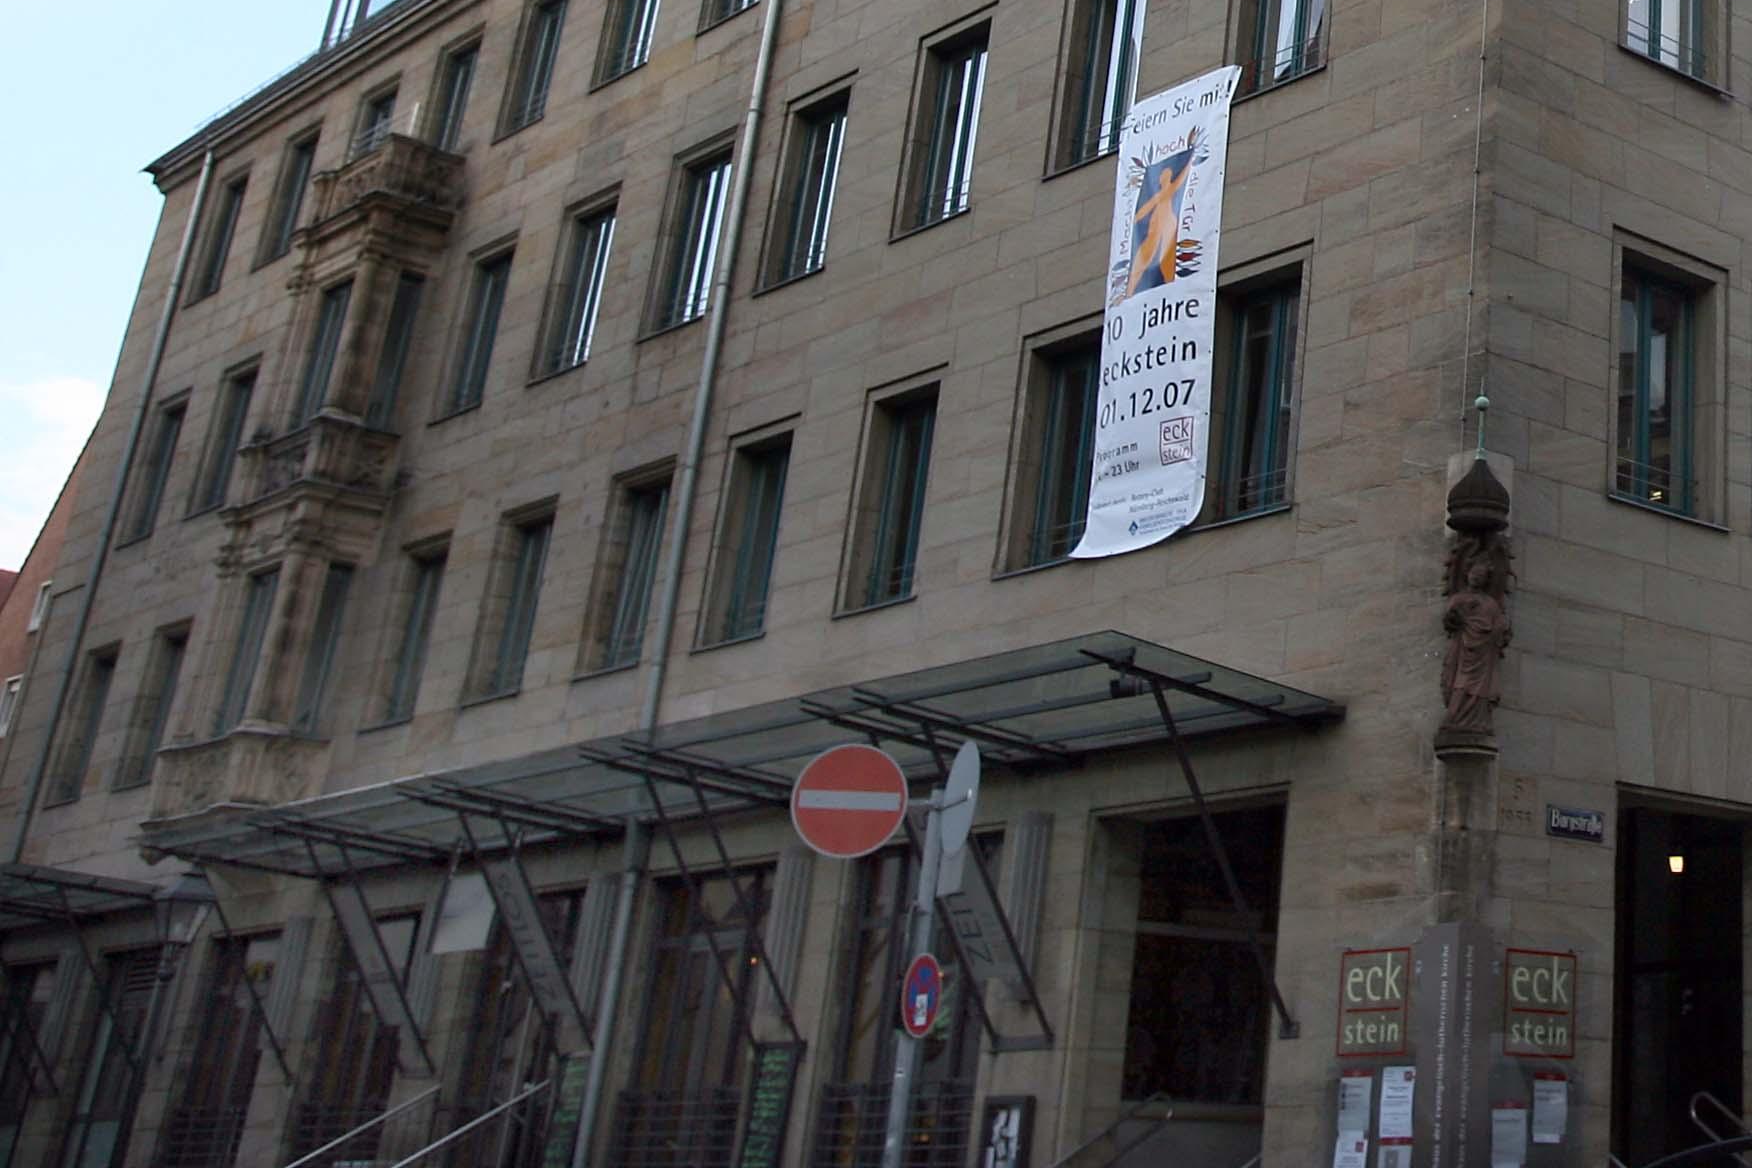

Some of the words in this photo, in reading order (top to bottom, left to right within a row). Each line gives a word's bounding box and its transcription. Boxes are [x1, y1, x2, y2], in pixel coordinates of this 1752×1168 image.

[1172, 96, 1194, 118] Sie
[1106, 316, 1124, 344] 10
[1138, 297, 1199, 339] jahre
[1103, 336, 1197, 386] eckstein
[1100, 379, 1196, 429] 01.12.07
[1163, 419, 1190, 442] eck
[1111, 464, 1123, 477] 23
[1124, 460, 1140, 473] Uhr
[1162, 444, 1190, 463] stein
[1346, 951, 1402, 1003] eck
[1511, 956, 1569, 1004] eck
[1344, 1015, 1400, 1045] stein
[1510, 1018, 1568, 1047] stein
